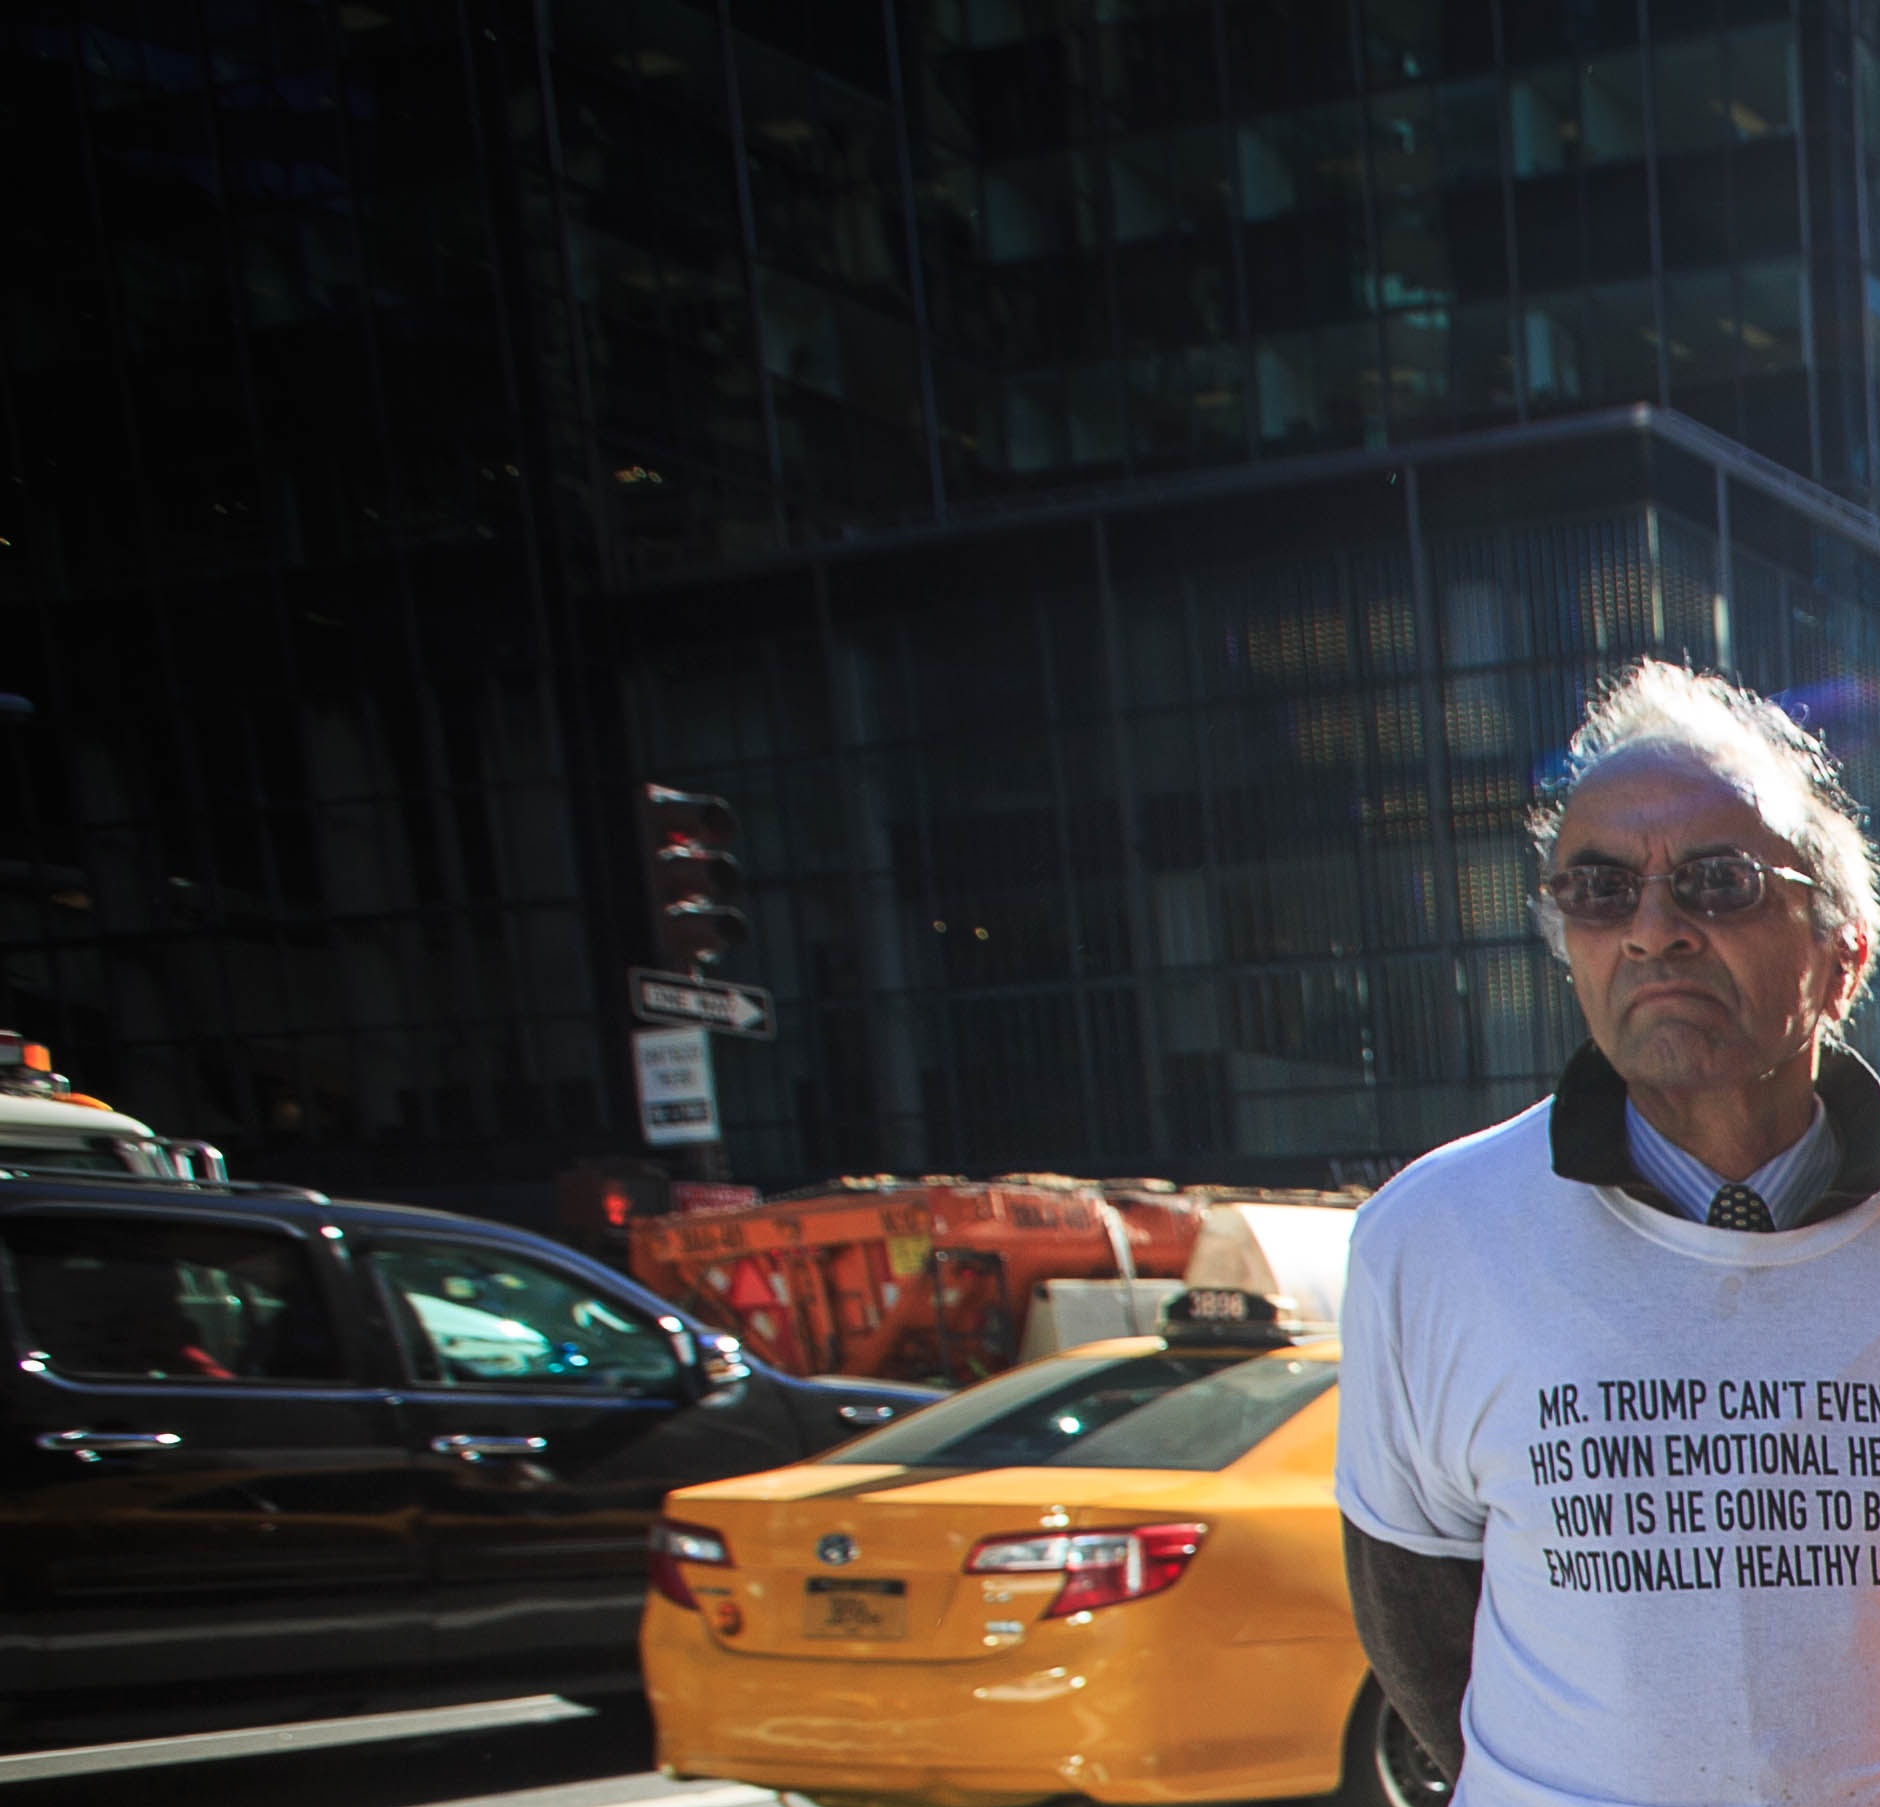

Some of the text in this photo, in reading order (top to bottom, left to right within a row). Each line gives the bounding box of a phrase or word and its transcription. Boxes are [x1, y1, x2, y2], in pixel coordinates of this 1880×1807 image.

[1539, 1387, 1588, 1429] MR.
[1598, 1379, 1706, 1423] TRUMP
[1719, 1381, 1806, 1420] CAN'T
[1530, 1443, 1573, 1486] HIS
[1581, 1435, 1655, 1479] OWN
[1666, 1433, 1839, 1477] EMOTIONAL
[1552, 1493, 1612, 1537] HOW
[1627, 1491, 1656, 1534] IS
[1668, 1490, 1706, 1533] HE
[1716, 1490, 1807, 1532] GOING
[1816, 1491, 1853, 1532] TO
[1543, 1546, 1725, 1592] EMOTIONALLY
[1736, 1545, 1861, 1588] HEALTHY
